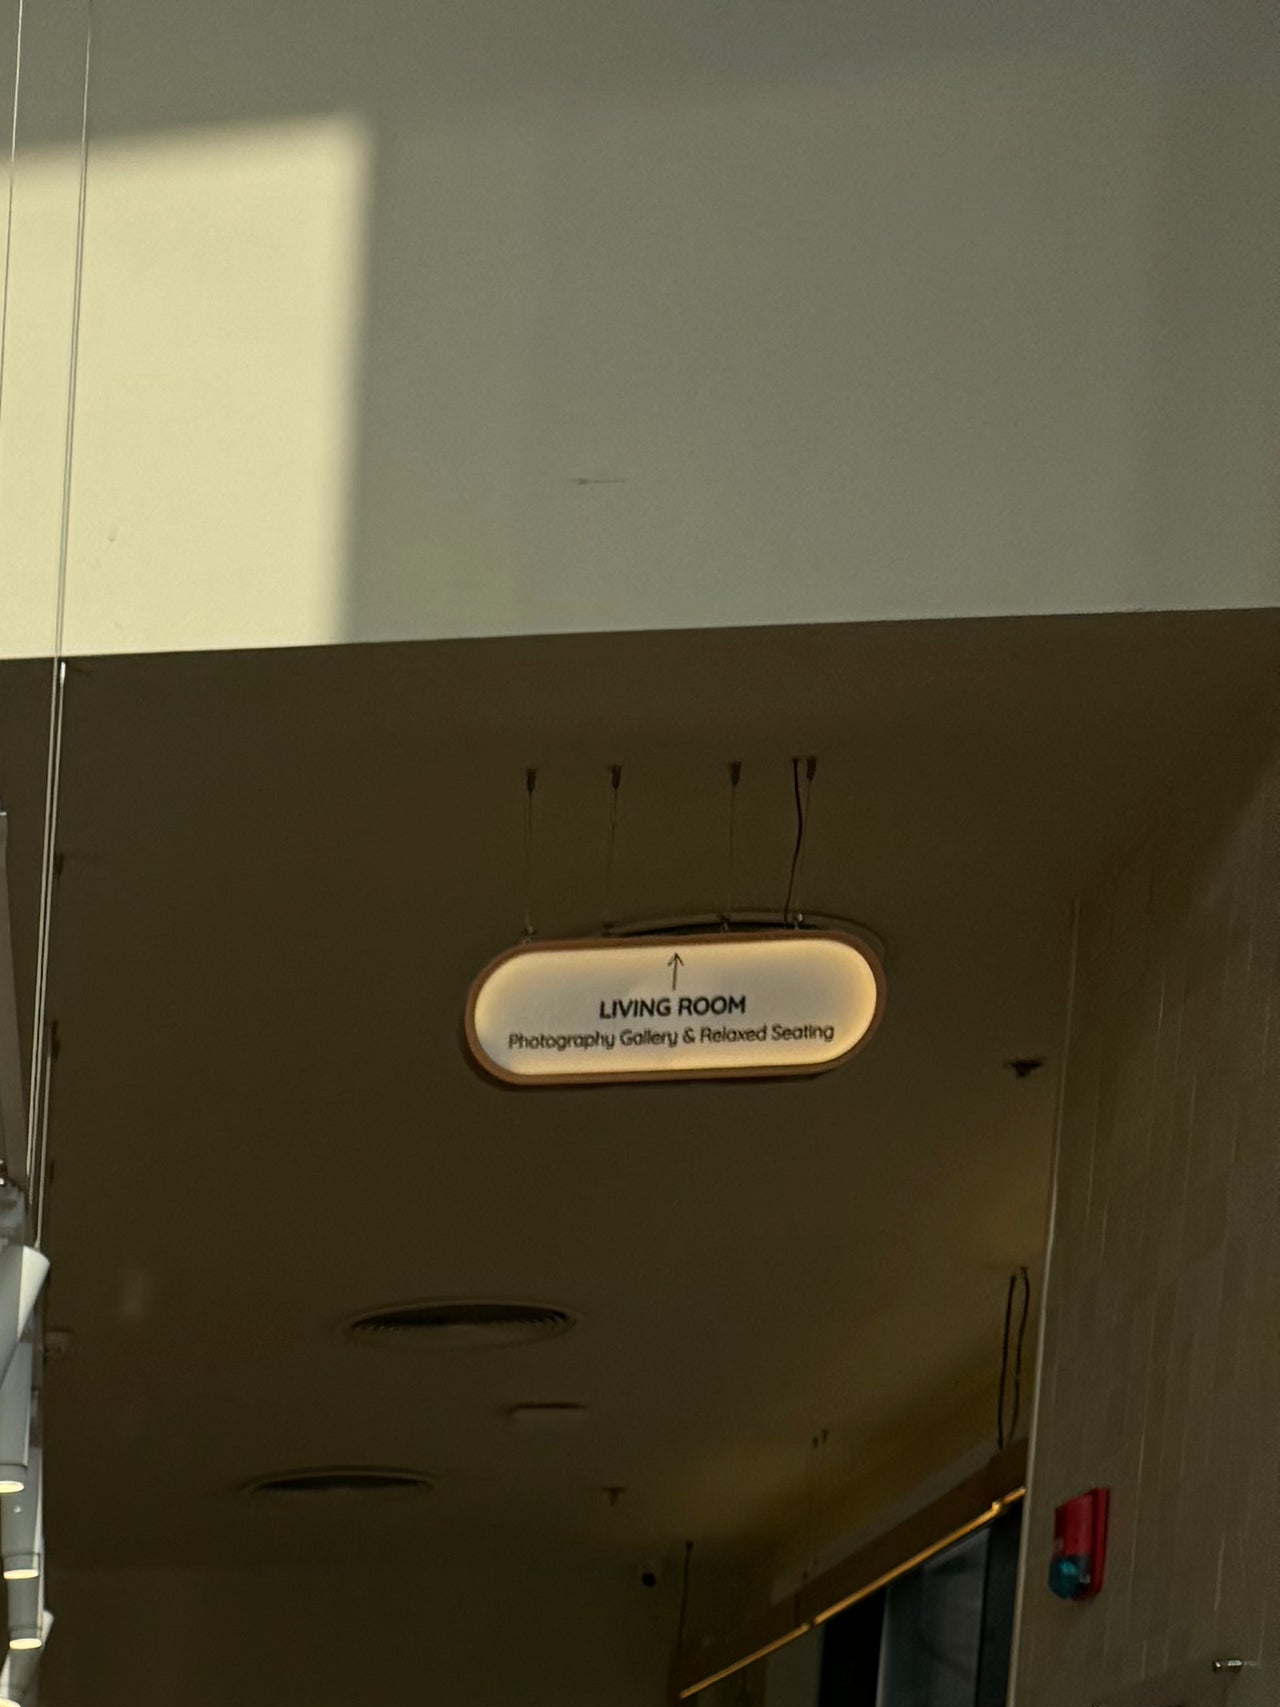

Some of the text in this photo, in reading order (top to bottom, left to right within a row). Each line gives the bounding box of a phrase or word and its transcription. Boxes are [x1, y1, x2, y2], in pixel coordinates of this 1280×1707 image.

[599, 994, 746, 1019] LIVING ROOM
[508, 1022, 835, 1051] Photography Gallery & Relaxed Seating
